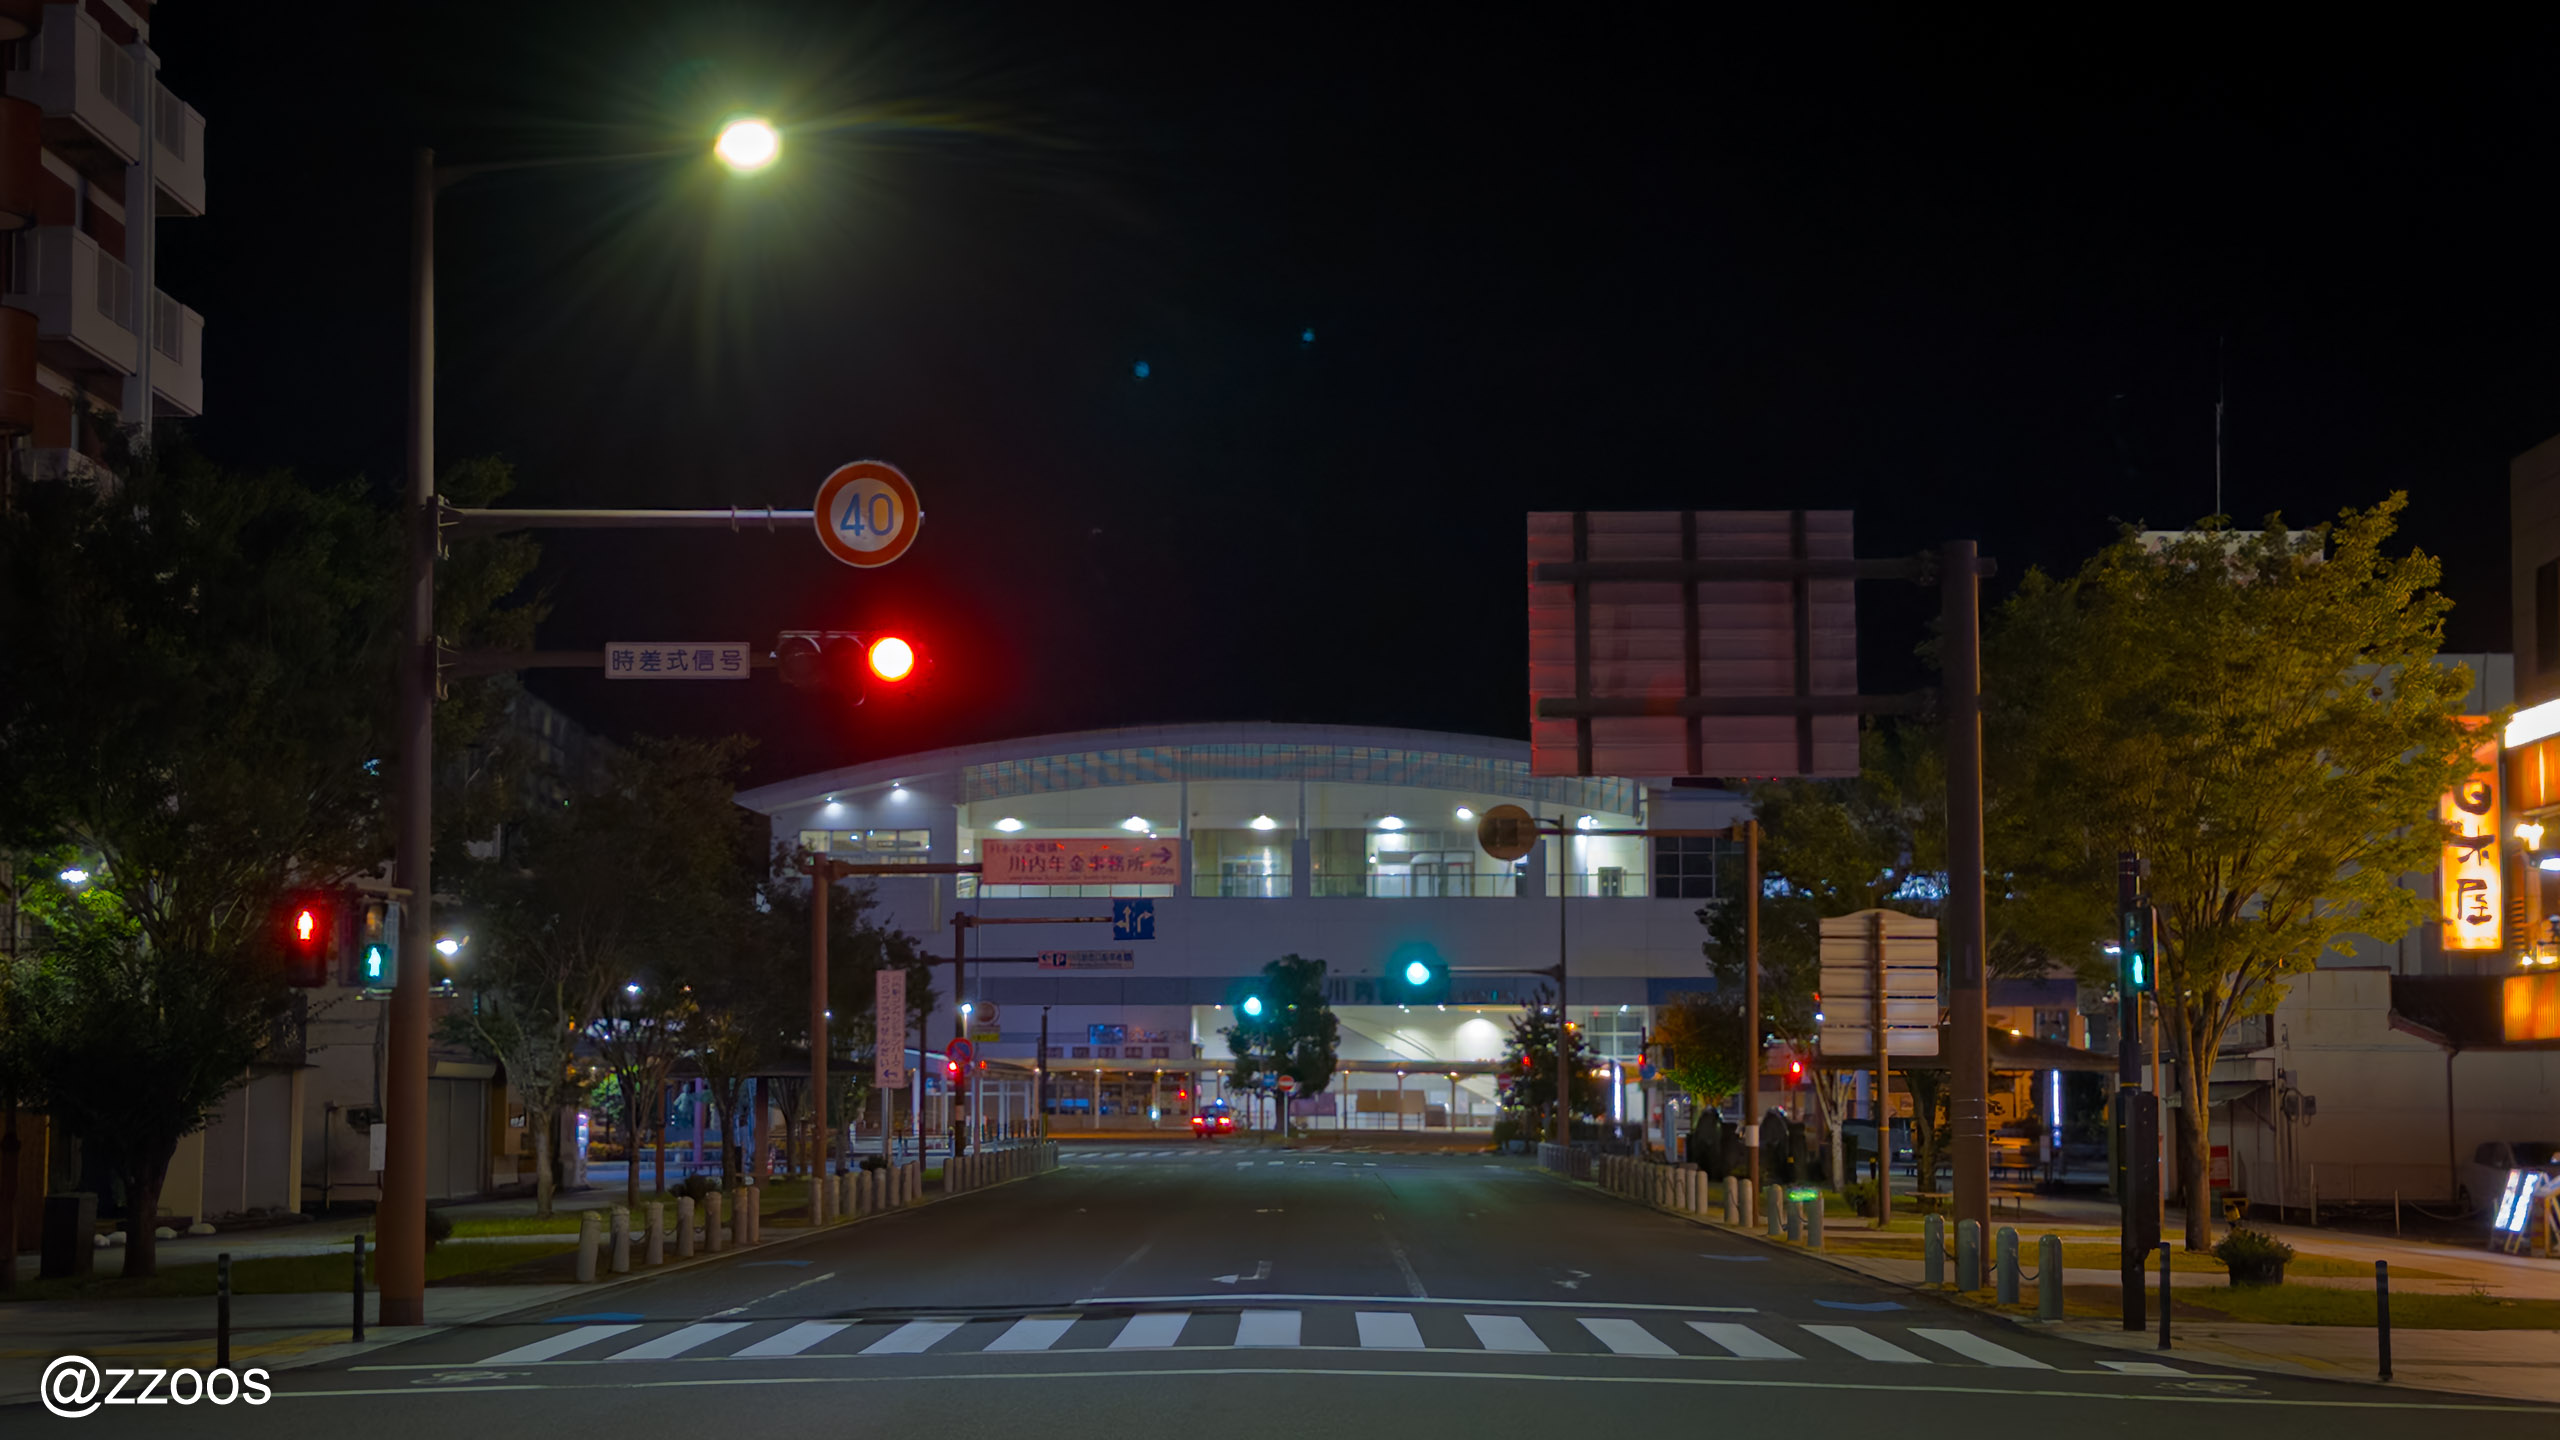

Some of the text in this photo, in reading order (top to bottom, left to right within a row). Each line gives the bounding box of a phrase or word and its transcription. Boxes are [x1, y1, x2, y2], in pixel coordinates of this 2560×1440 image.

[841, 493, 894, 536] 40
[611, 649, 742, 672] 時差式信号
[1008, 854, 1144, 873] 川内年金事務所
